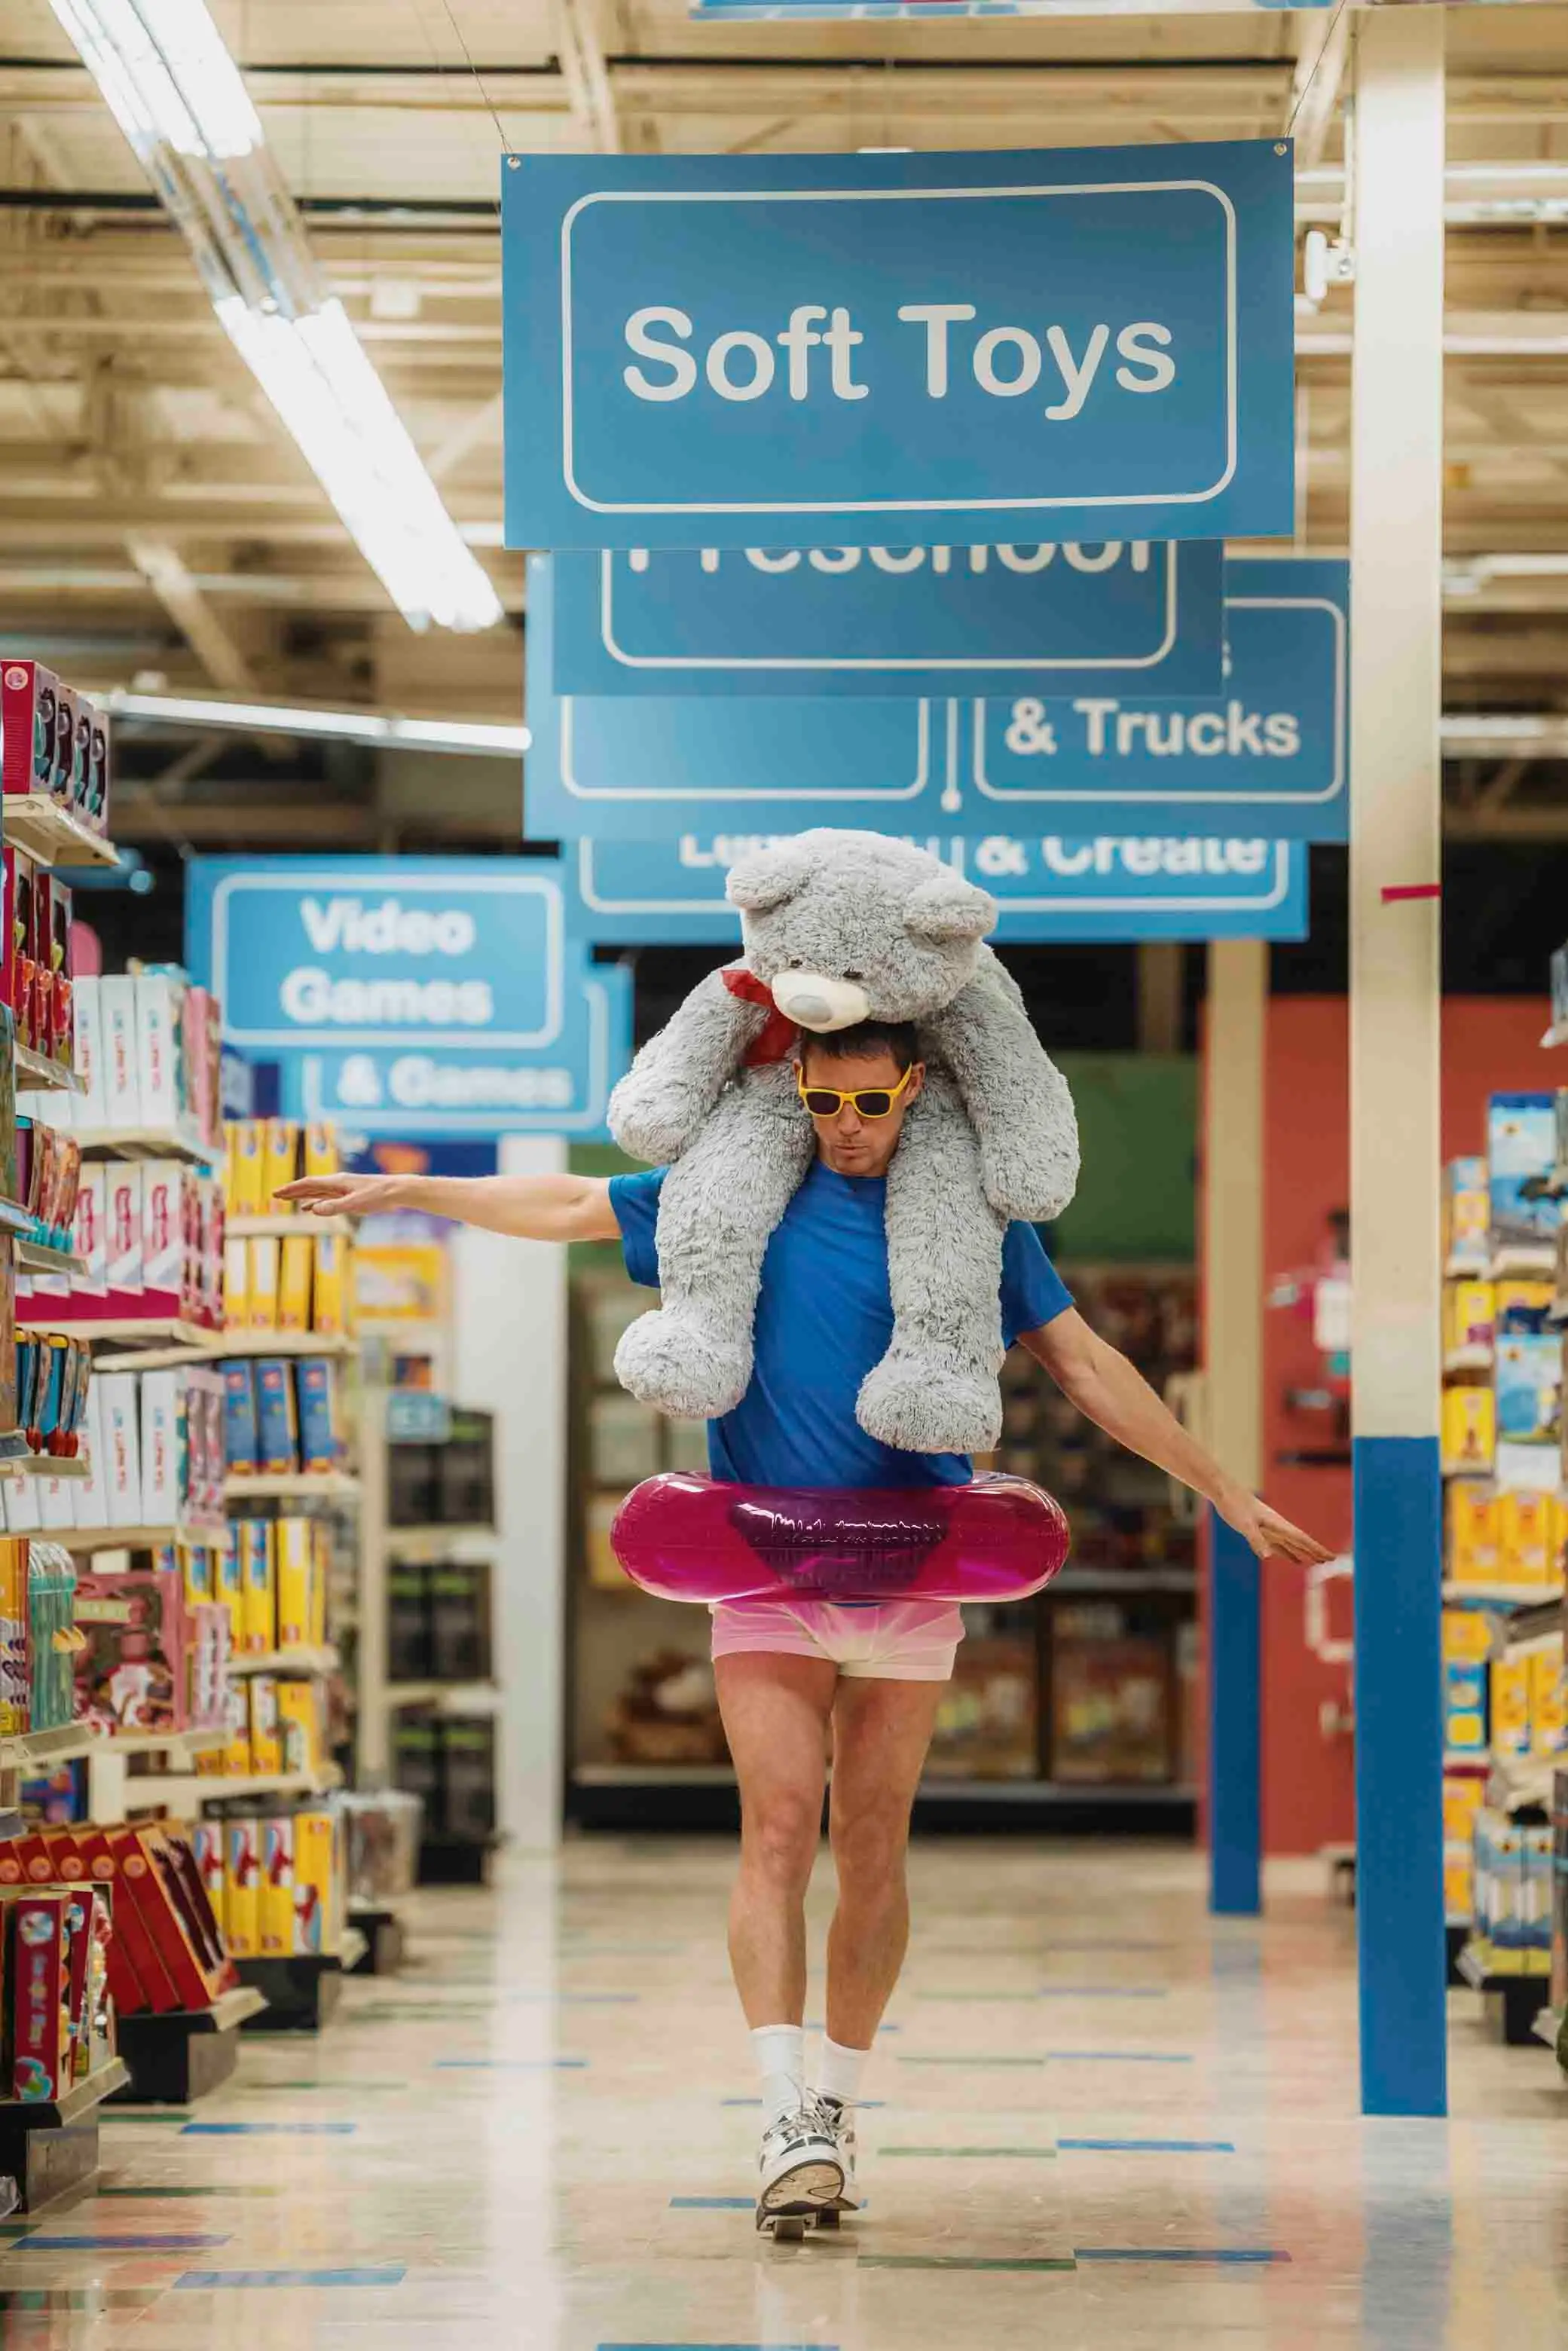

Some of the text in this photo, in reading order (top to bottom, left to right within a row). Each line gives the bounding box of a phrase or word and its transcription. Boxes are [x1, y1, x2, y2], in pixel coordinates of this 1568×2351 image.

[623, 304, 1175, 420] Soft Toys
[1005, 698, 1300, 756] & Trucks
[976, 836, 1028, 876] &
[1042, 836, 1267, 875] Create
[301, 898, 476, 954] Video
[280, 968, 493, 1024] Games
[338, 1056, 573, 1106] & Games
